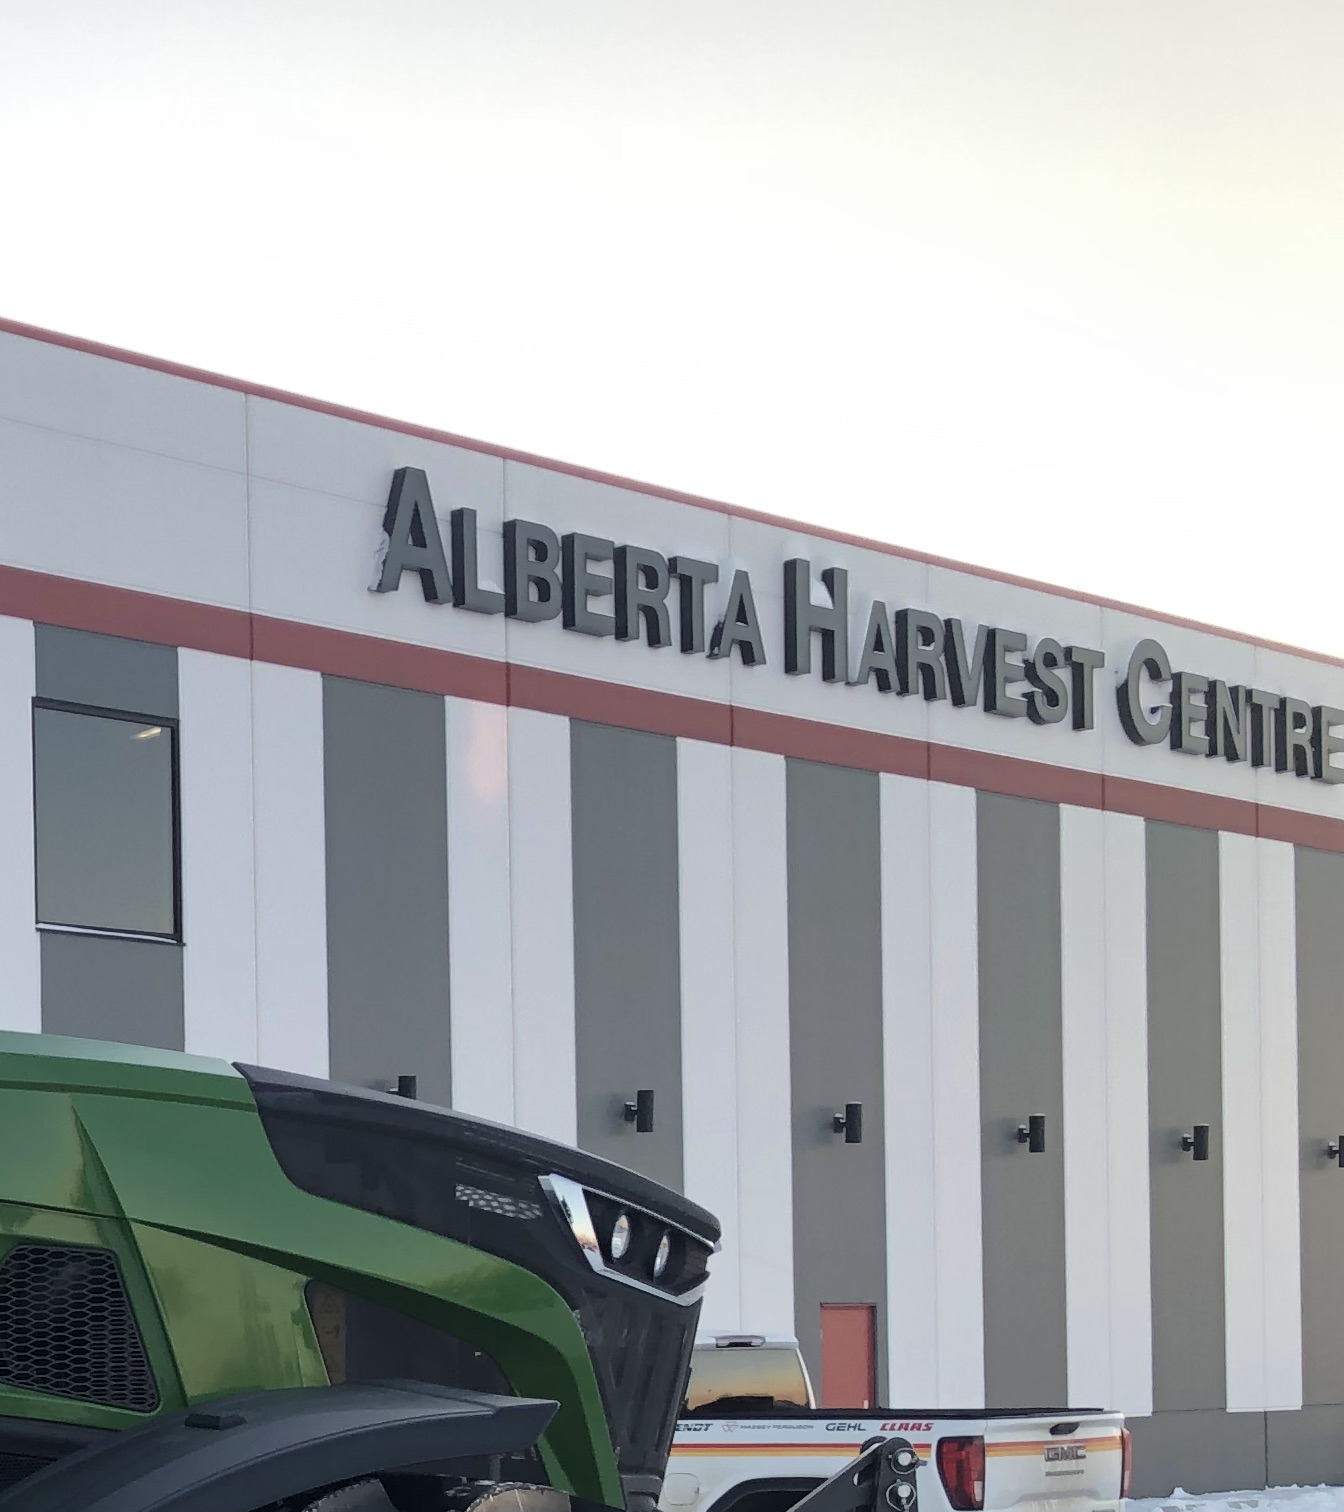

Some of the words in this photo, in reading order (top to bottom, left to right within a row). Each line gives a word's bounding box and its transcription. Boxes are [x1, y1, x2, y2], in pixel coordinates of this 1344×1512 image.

[368, 466, 767, 666] ALBERTA
[783, 557, 1105, 732] HARVEST
[1115, 638, 1344, 786] CENTRE
[675, 1423, 713, 1432] ENDT
[825, 1422, 867, 1432] GEHL
[879, 1422, 934, 1432] CLAAS
[1044, 1445, 1087, 1462] GMC
